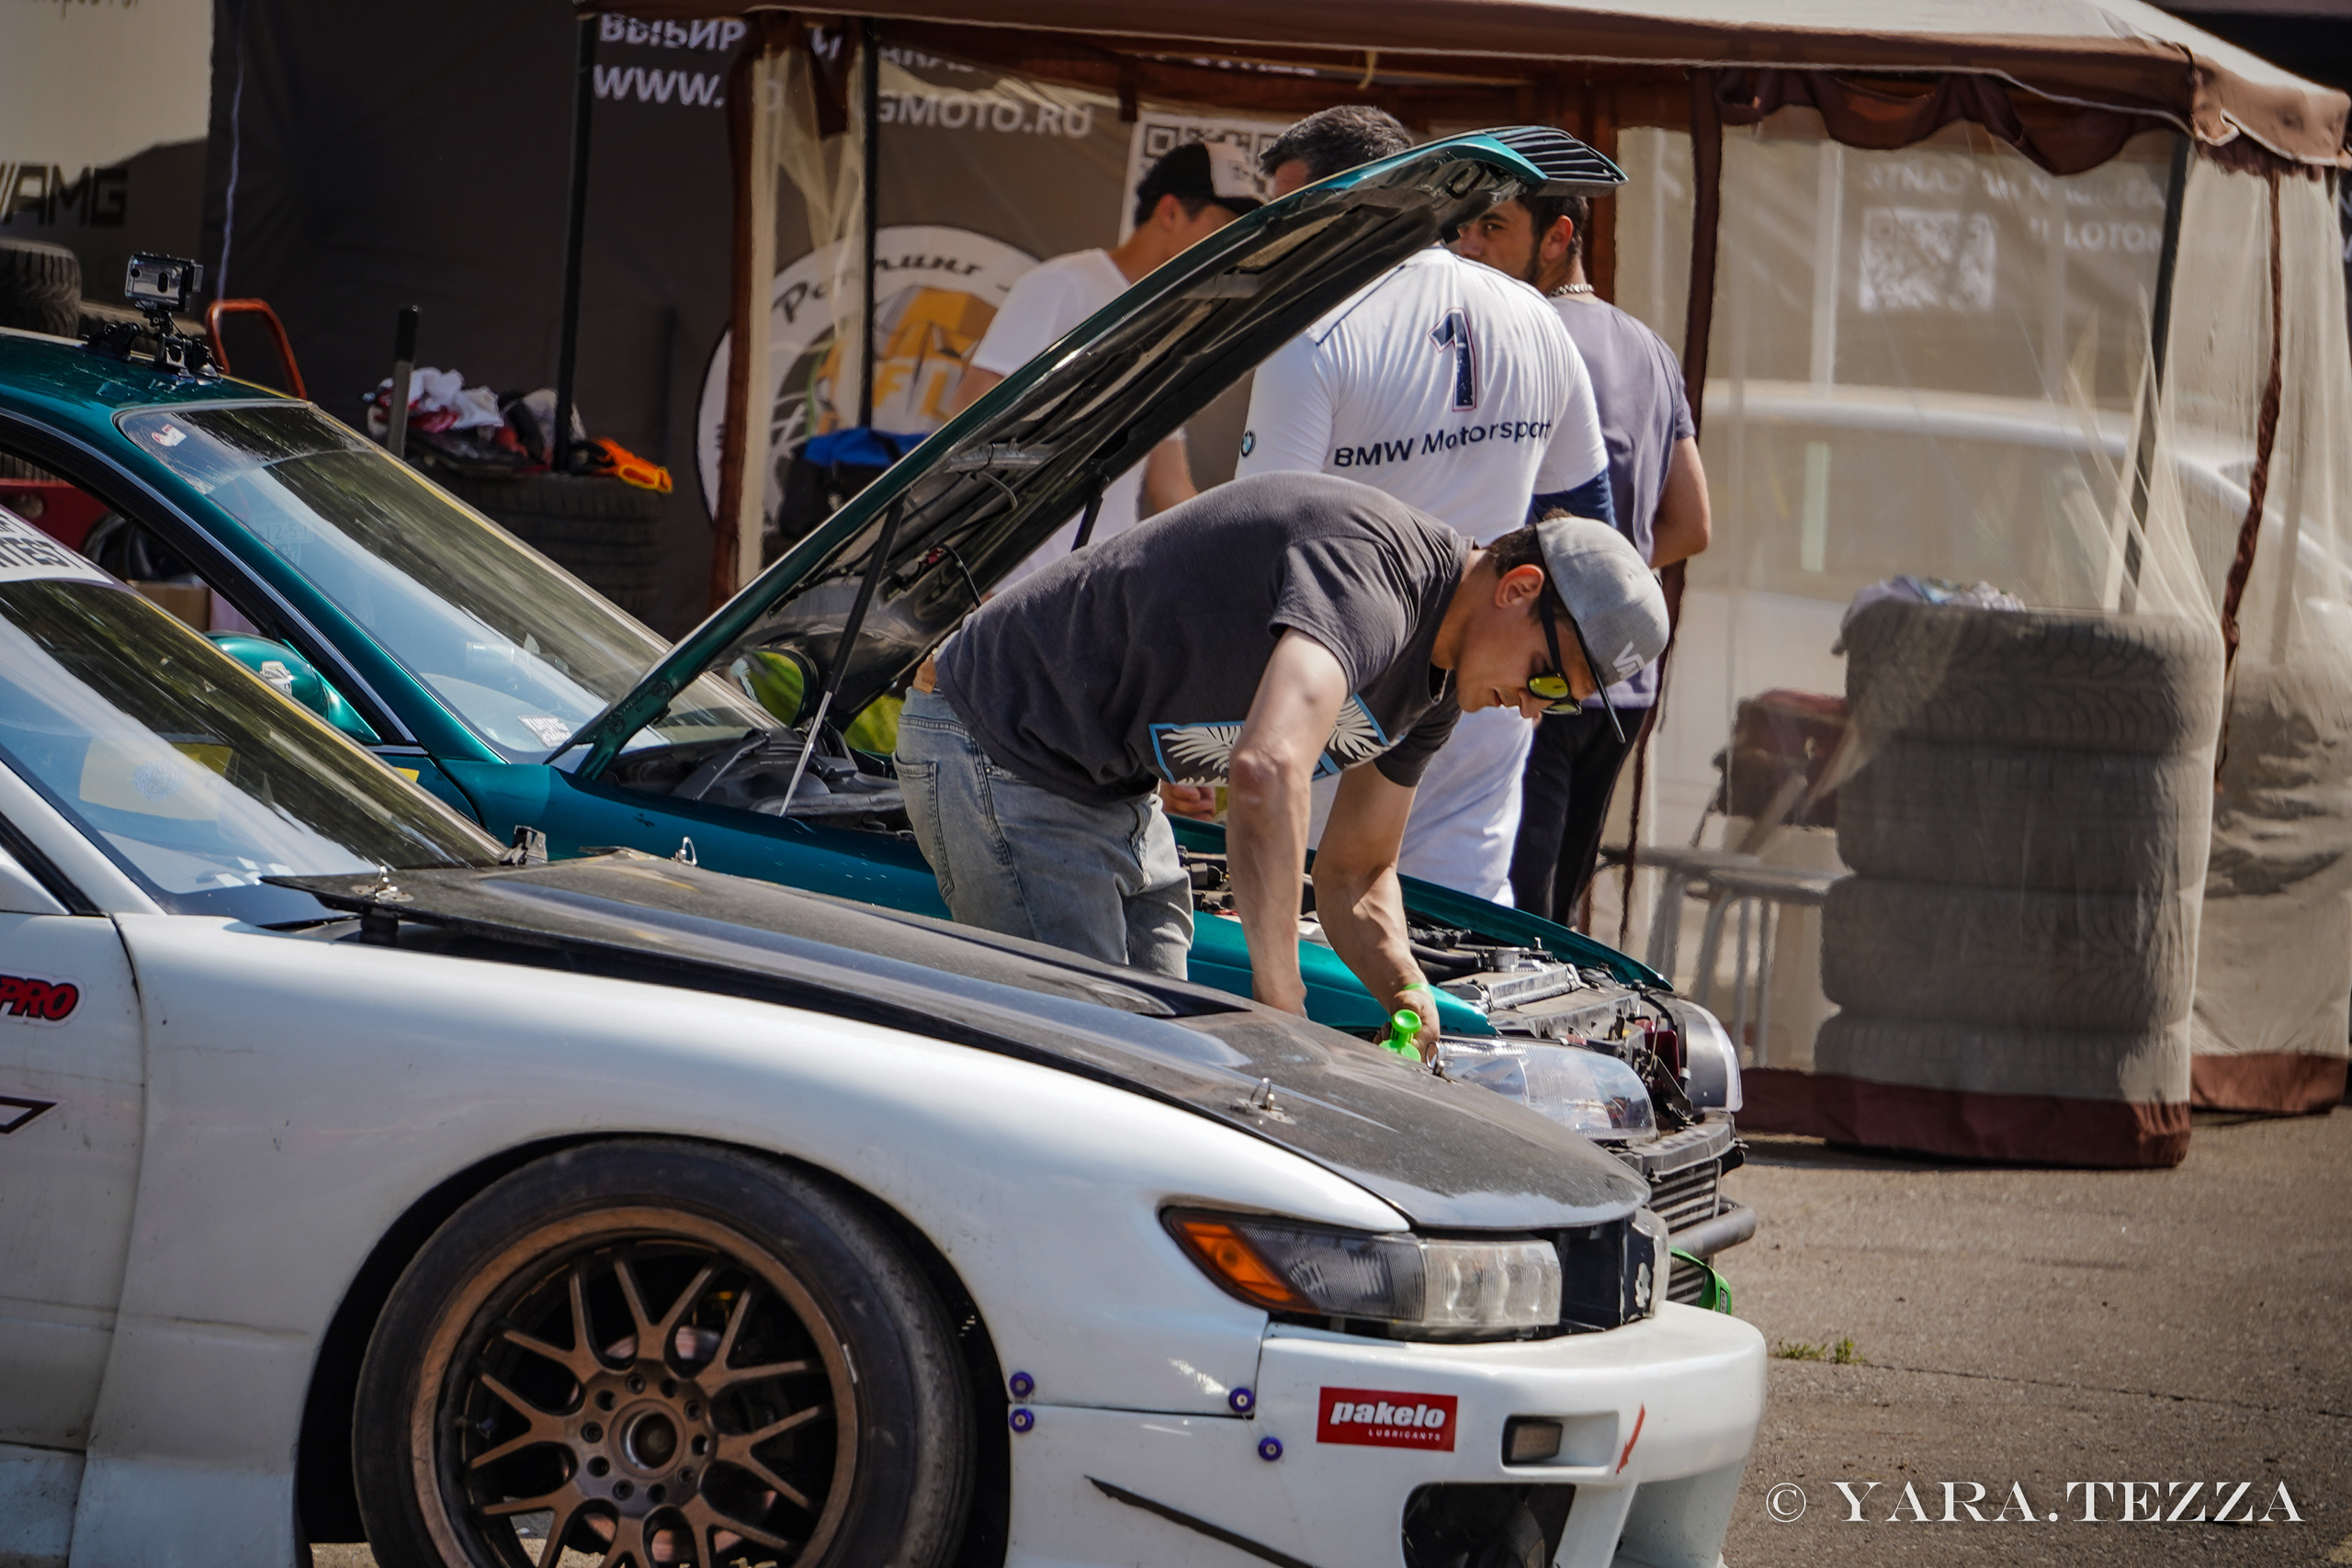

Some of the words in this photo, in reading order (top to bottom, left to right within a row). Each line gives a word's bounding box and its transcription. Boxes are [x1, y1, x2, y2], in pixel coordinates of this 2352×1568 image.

[1428, 308, 1477, 412] 1
[1334, 437, 1414, 468] BMW
[1420, 419, 1552, 456] Motorsport
[0, 974, 80, 1021] PRO
[1329, 1400, 1446, 1429] pakelo
[1368, 1427, 1442, 1441] LUBRICANTS
